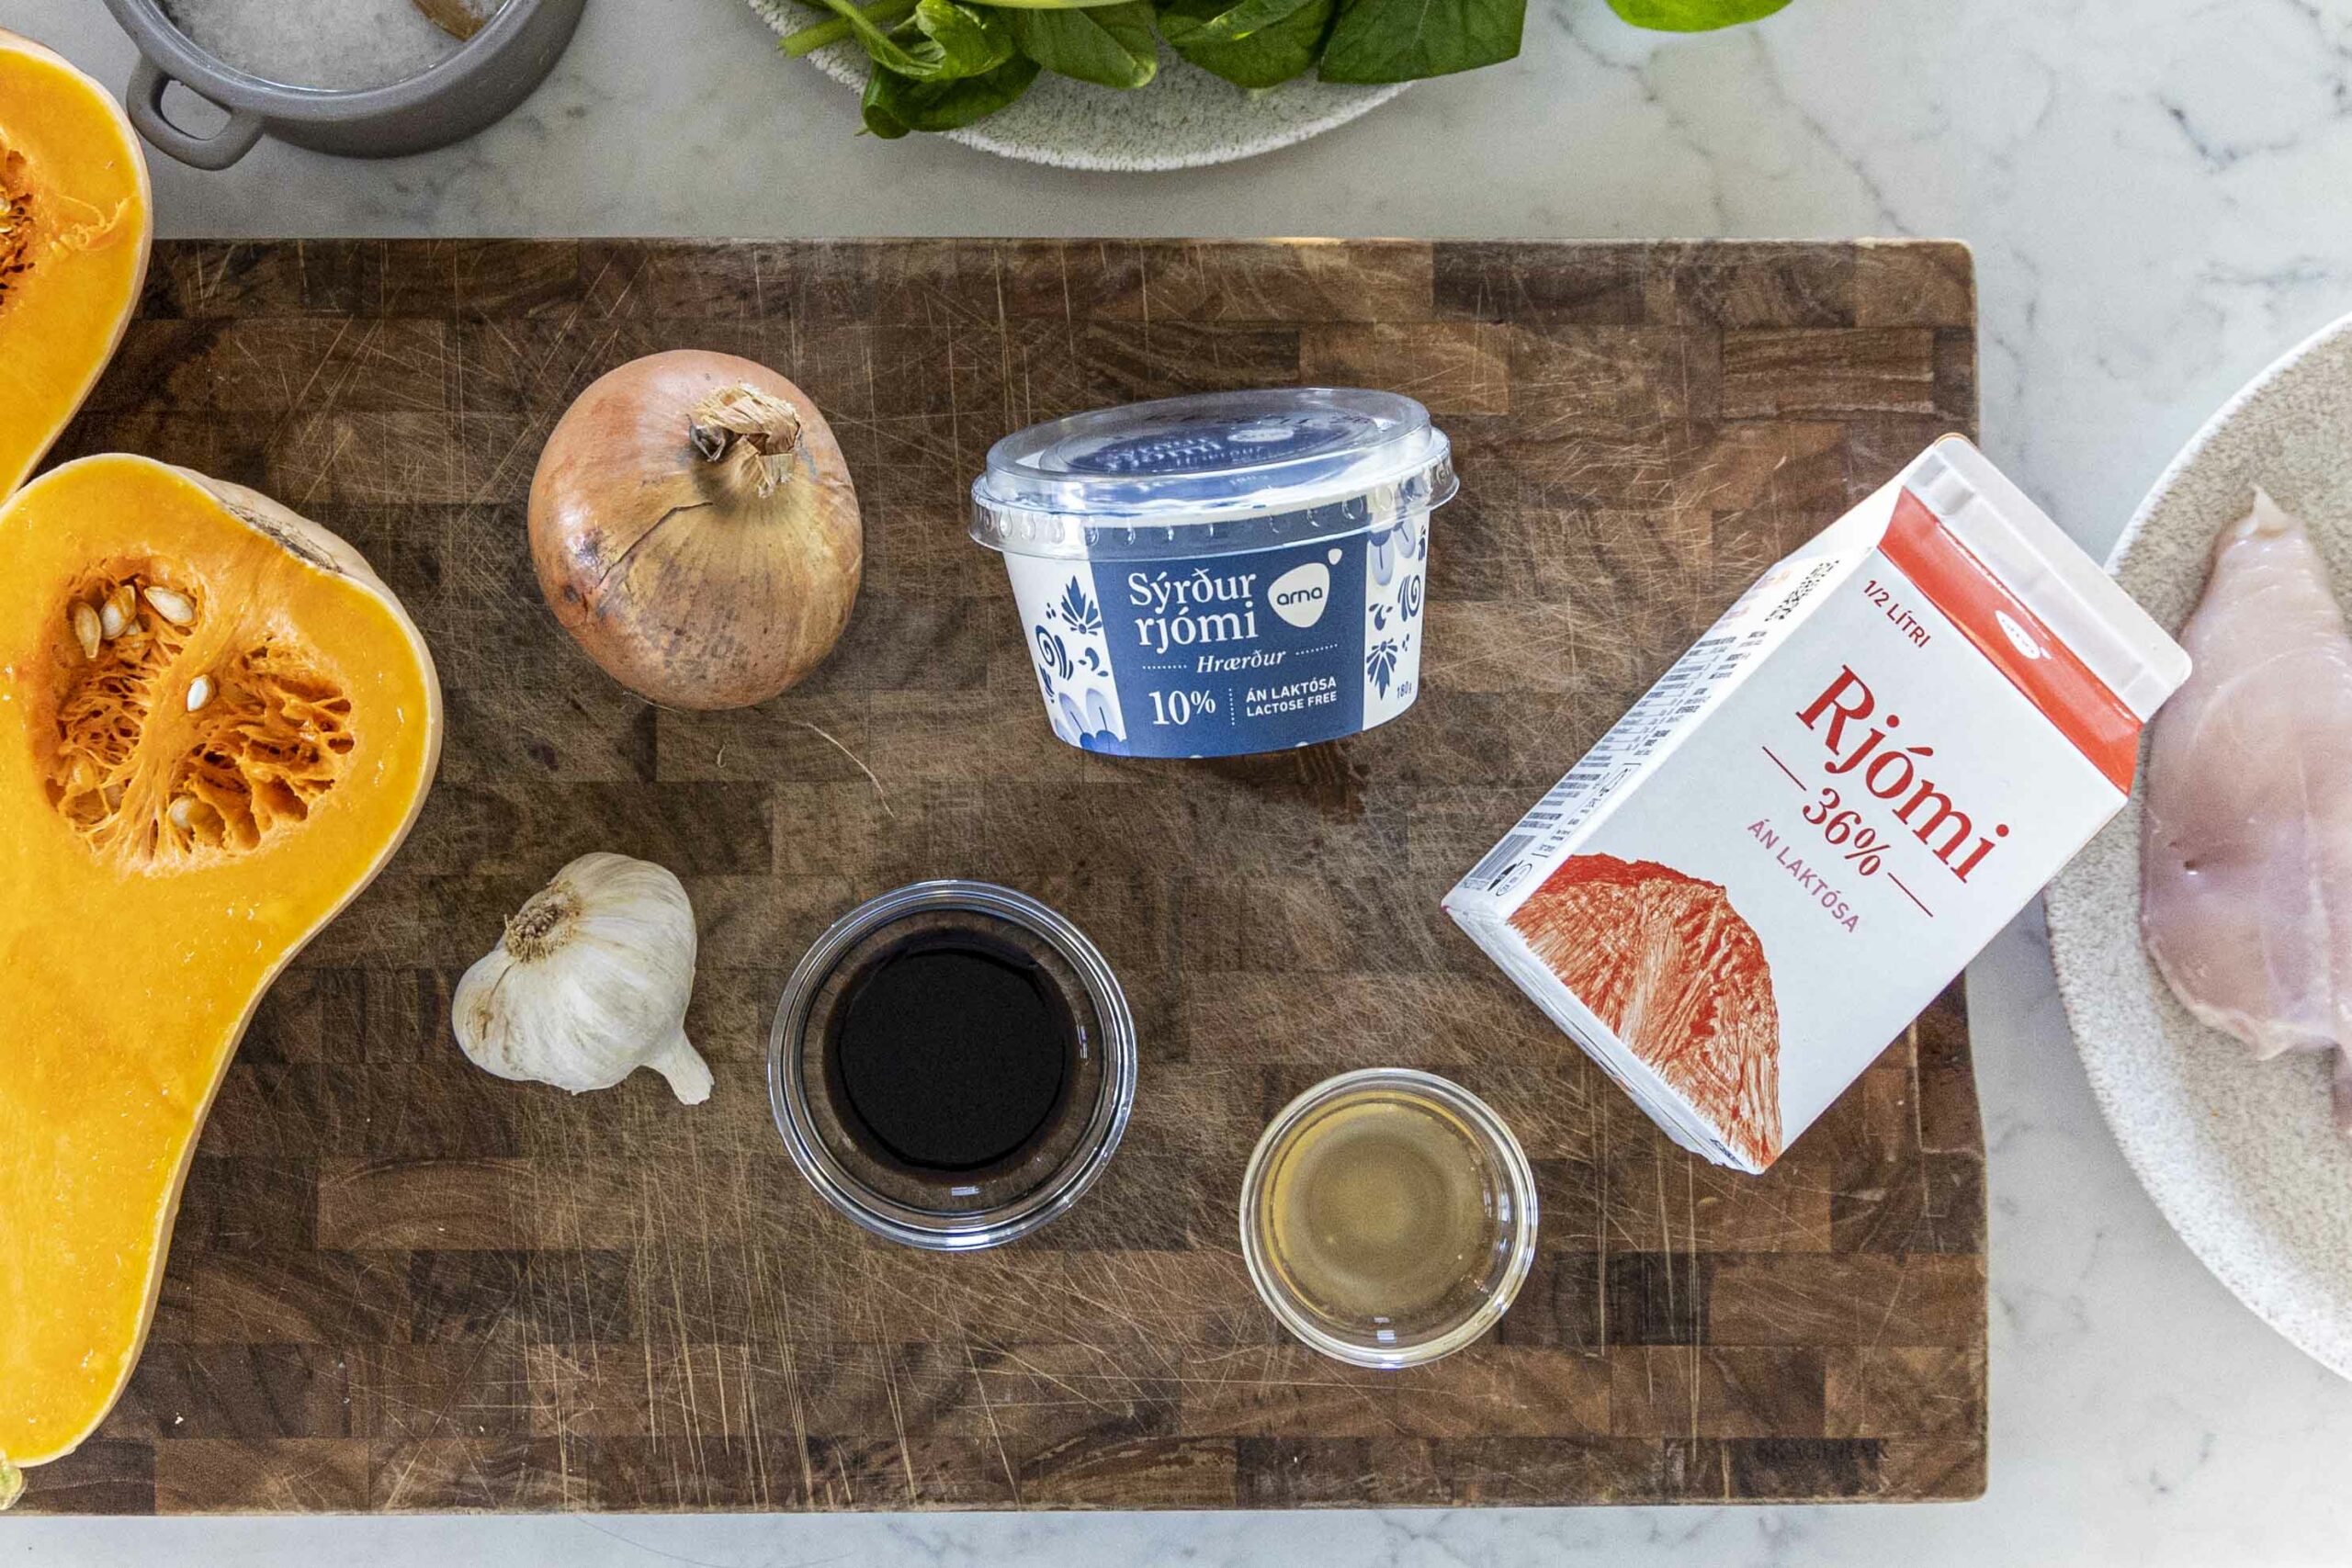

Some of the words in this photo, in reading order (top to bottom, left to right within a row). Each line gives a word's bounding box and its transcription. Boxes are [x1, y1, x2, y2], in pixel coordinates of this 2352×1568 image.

[1127, 568, 1257, 615] Sýrður
[1276, 586, 1323, 606] arna
[1863, 580, 1890, 608] 1/2
[1886, 604, 1930, 649] LÍTRI
[1134, 602, 1259, 655] rjómi
[1197, 649, 1286, 673] Hrærður
[1148, 690, 1216, 726] 10%
[1246, 685, 1267, 703] ÁN
[1271, 676, 1337, 701] LAKTÓSA
[1246, 698, 1304, 717] LACTOSE
[1307, 691, 1337, 708] FREE
[1796, 664, 2009, 883] Rjómi
[1803, 788, 1889, 877] 36%
[1749, 818, 1779, 849] ÁN
[1777, 847, 1859, 932] LAKTÓSA
